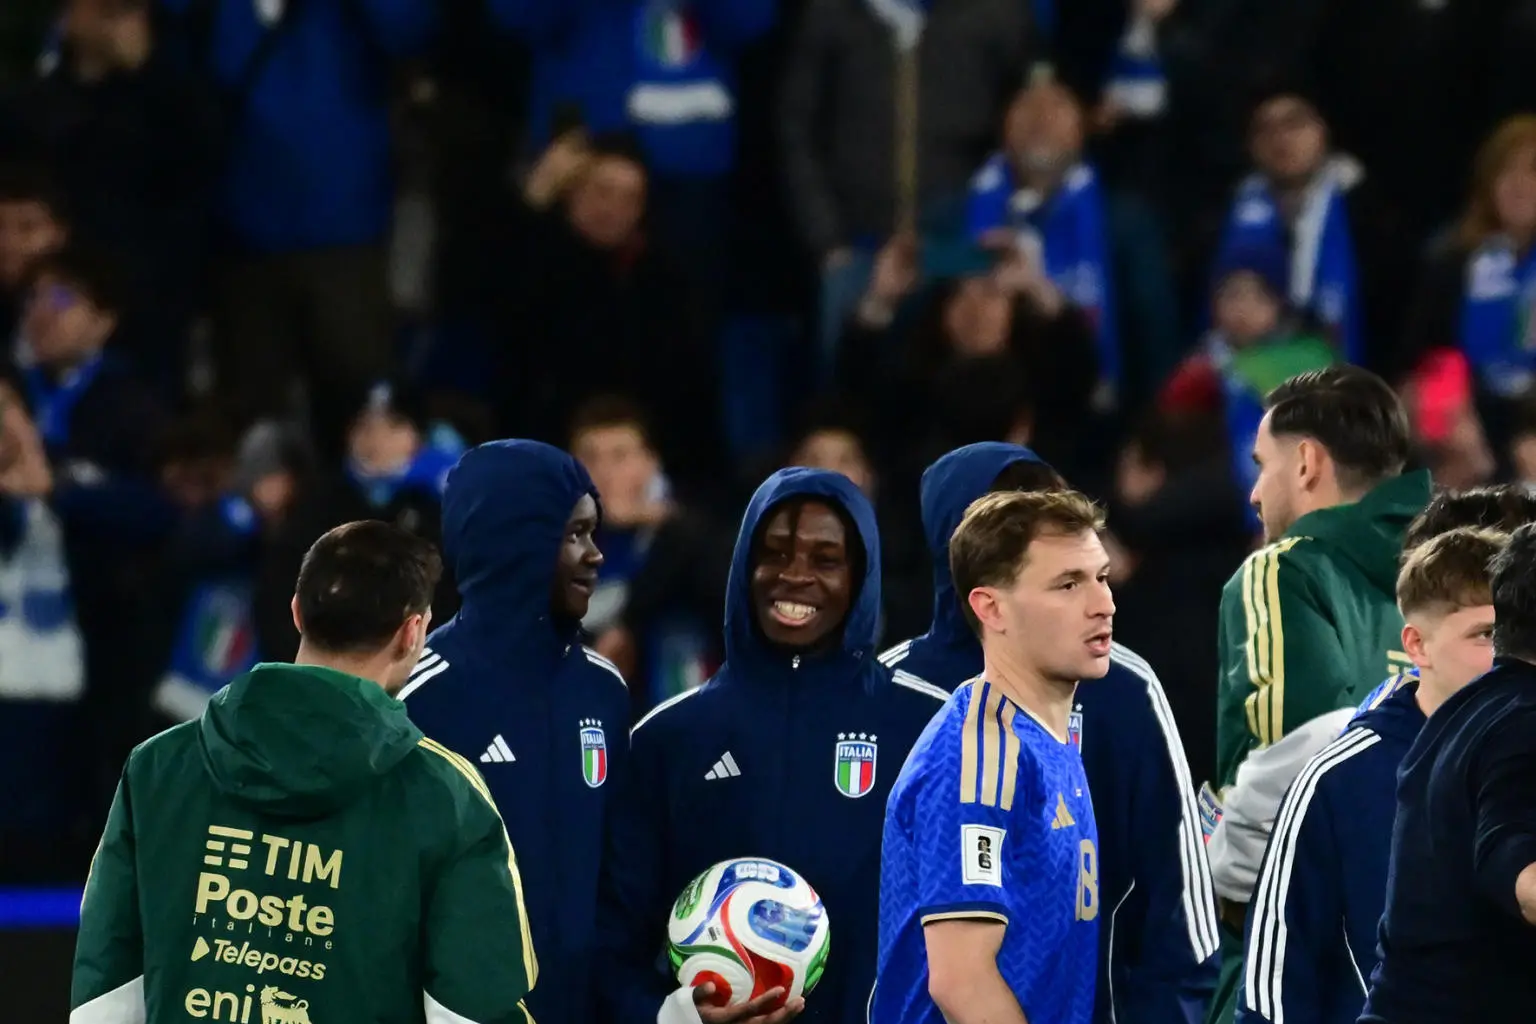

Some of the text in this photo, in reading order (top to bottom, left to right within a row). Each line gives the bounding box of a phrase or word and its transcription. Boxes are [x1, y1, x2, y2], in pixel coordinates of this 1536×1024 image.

[840, 746, 873, 758] ITALIA
[262, 834, 343, 888] TIM
[195, 872, 335, 936] Poste
[214, 936, 326, 980] Telepass
[184, 984, 255, 1024] eni
